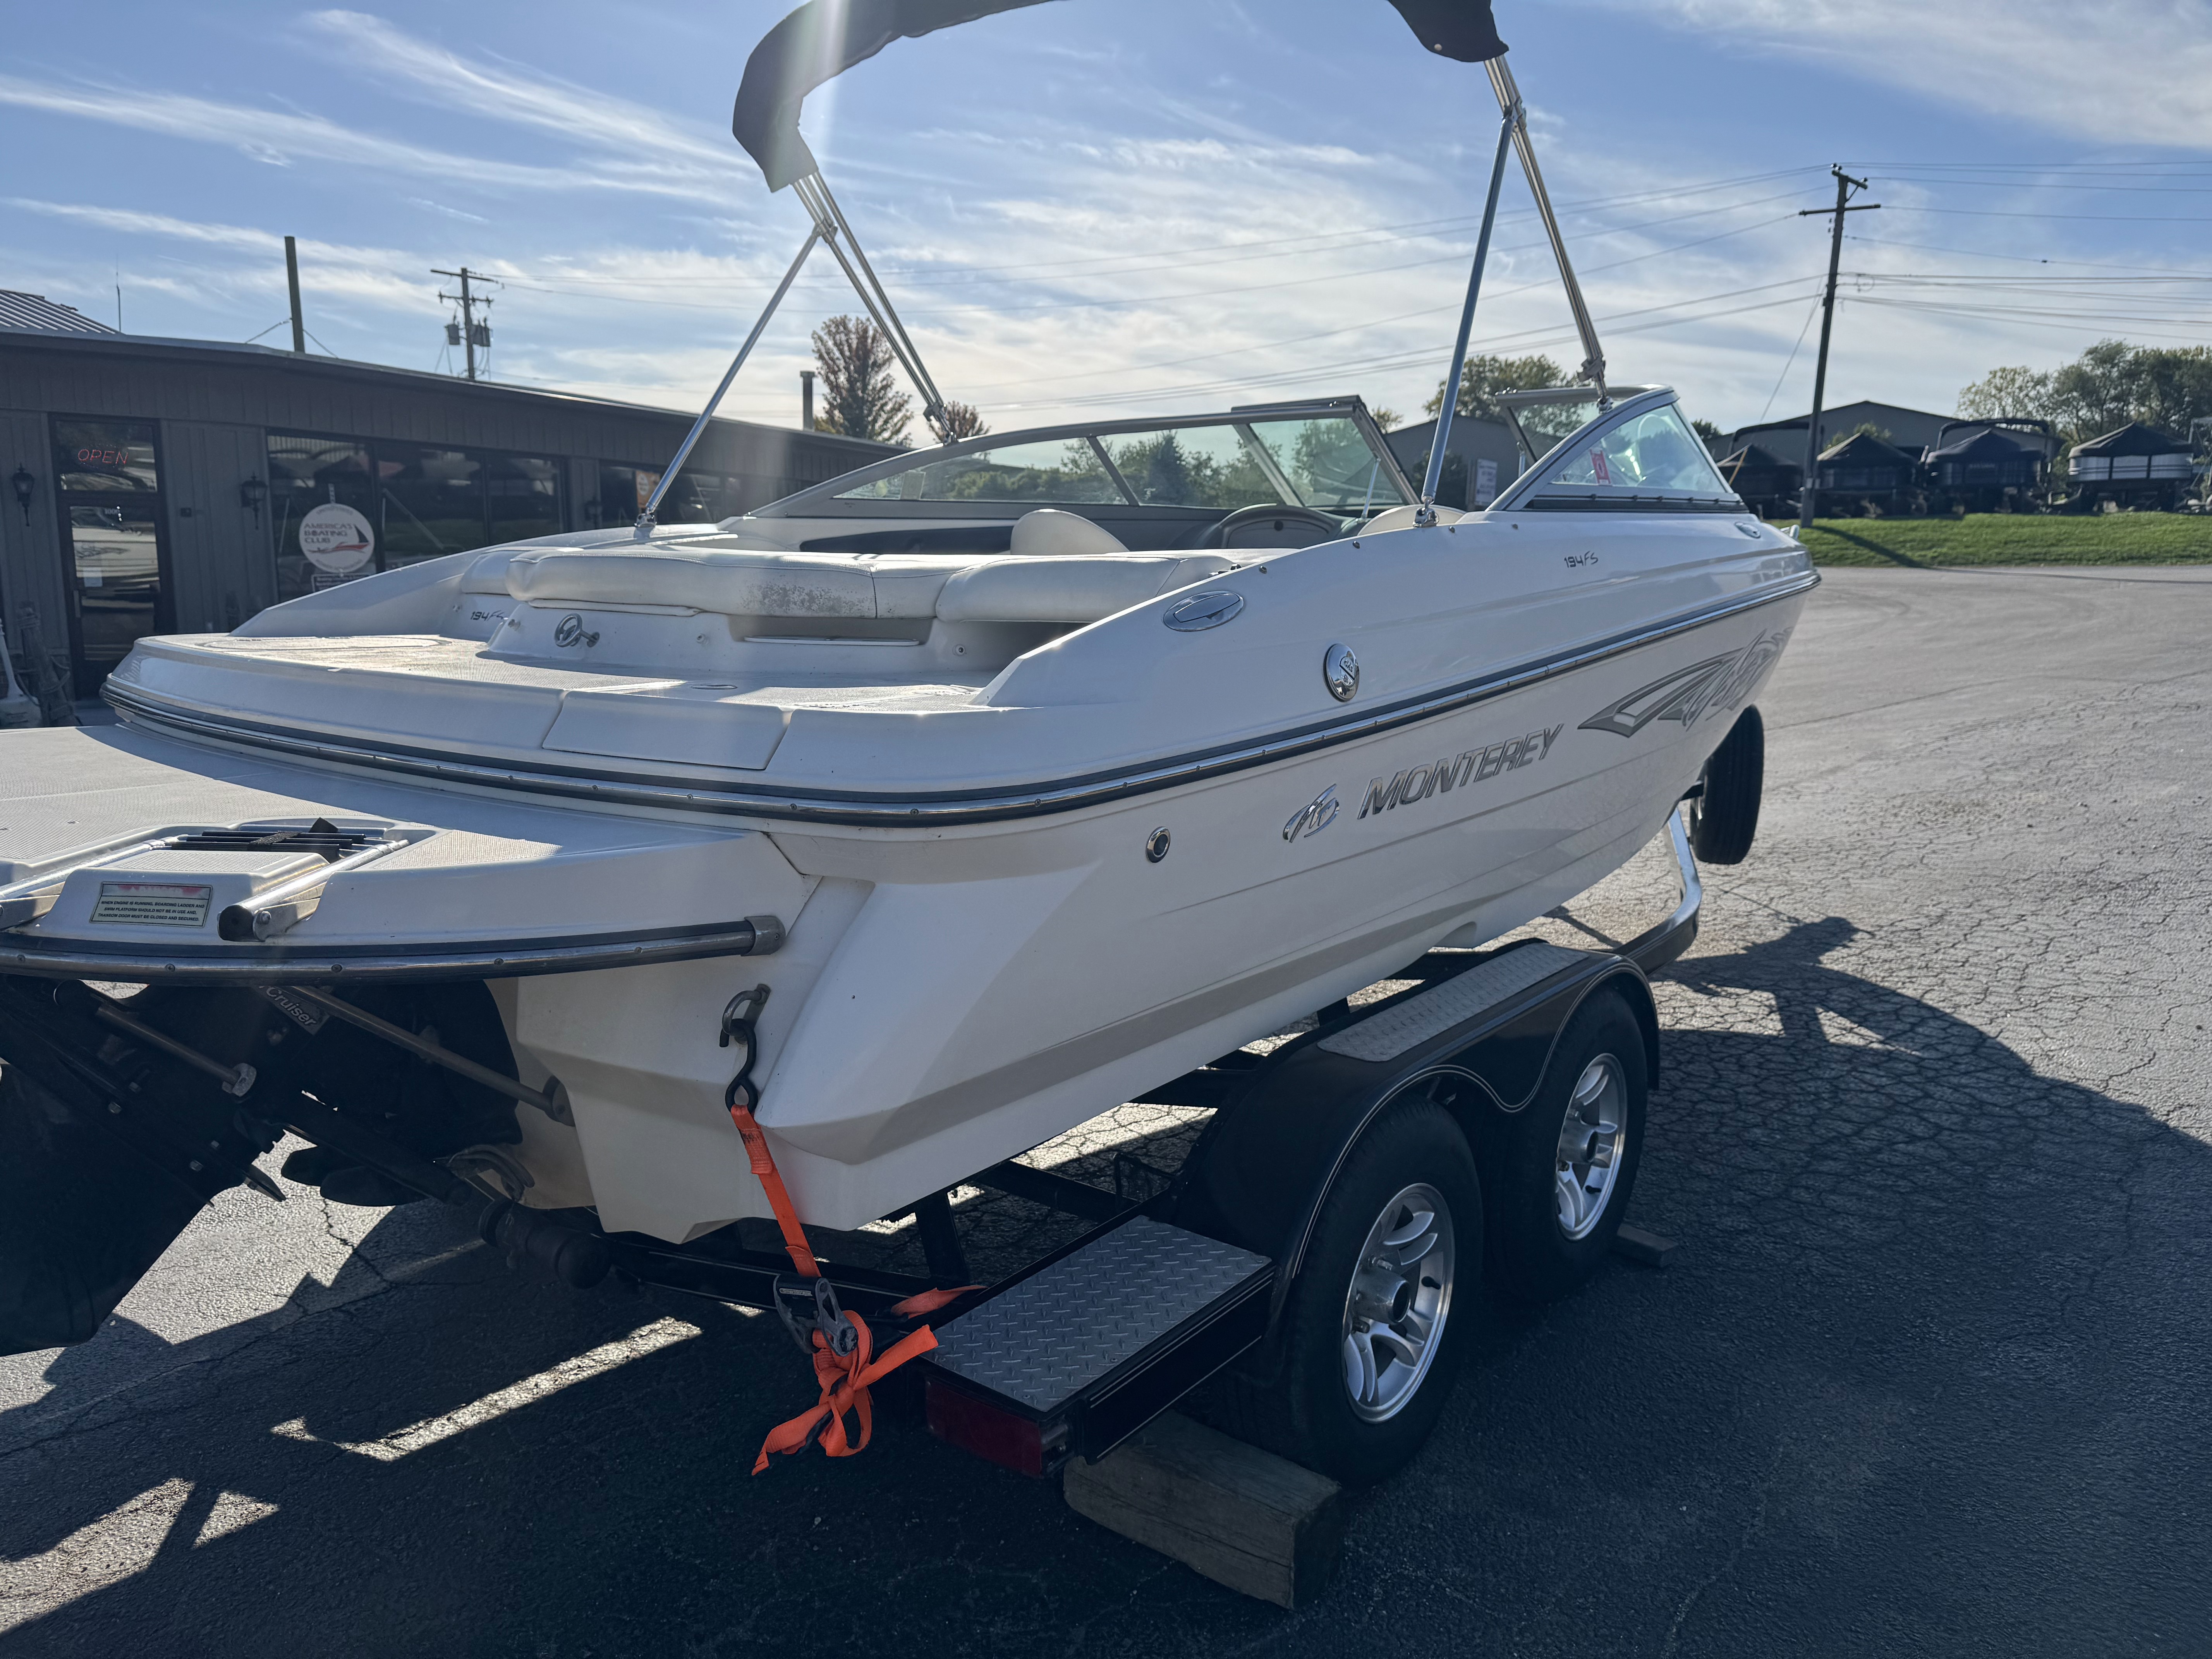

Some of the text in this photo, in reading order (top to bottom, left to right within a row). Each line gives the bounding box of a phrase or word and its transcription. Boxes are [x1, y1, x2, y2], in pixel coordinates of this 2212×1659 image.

[78, 449, 128, 464] OPEN
[1564, 550, 1598, 568] 194FS
[1344, 660, 1353, 672] GAS
[1357, 723, 1564, 819] MONTEREY
[259, 986, 317, 1025] Cruiser
